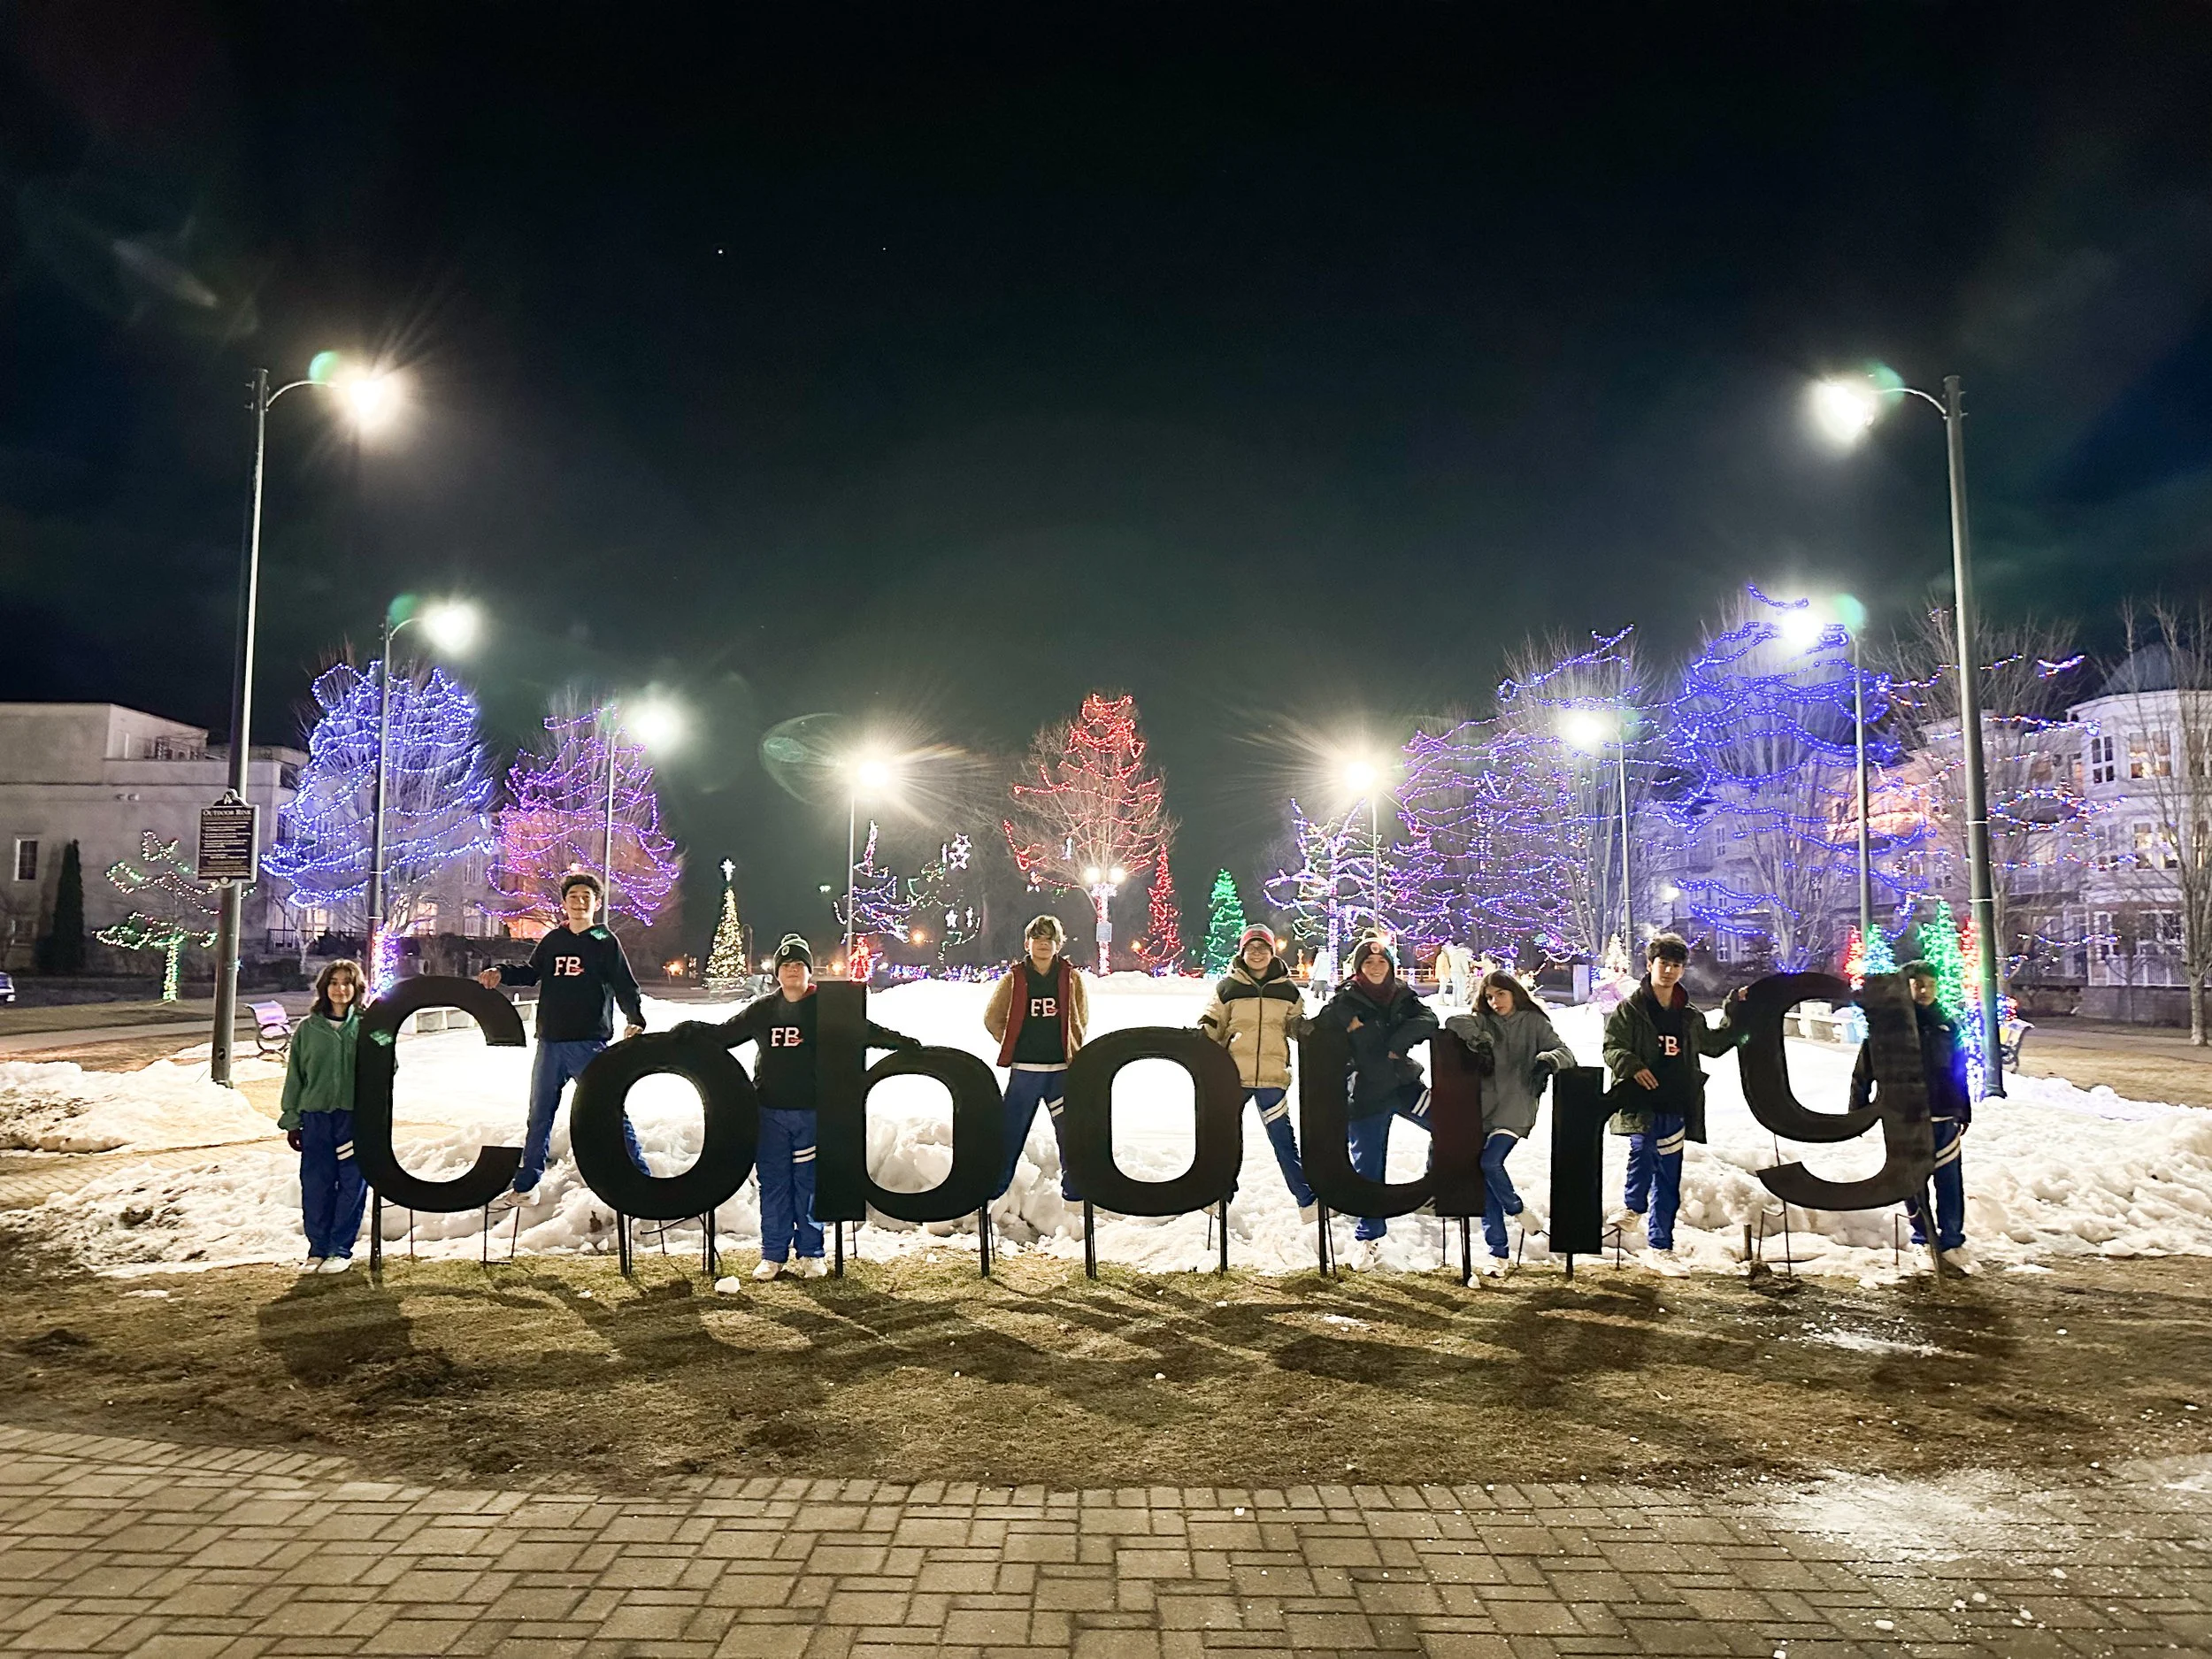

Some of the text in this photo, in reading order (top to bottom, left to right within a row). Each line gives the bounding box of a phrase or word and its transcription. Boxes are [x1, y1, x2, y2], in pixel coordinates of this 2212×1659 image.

[554, 956, 581, 976] FB
[1031, 997, 1056, 1018] FB
[771, 1026, 801, 1047] FB
[355, 972, 1934, 1255] Cobourg
